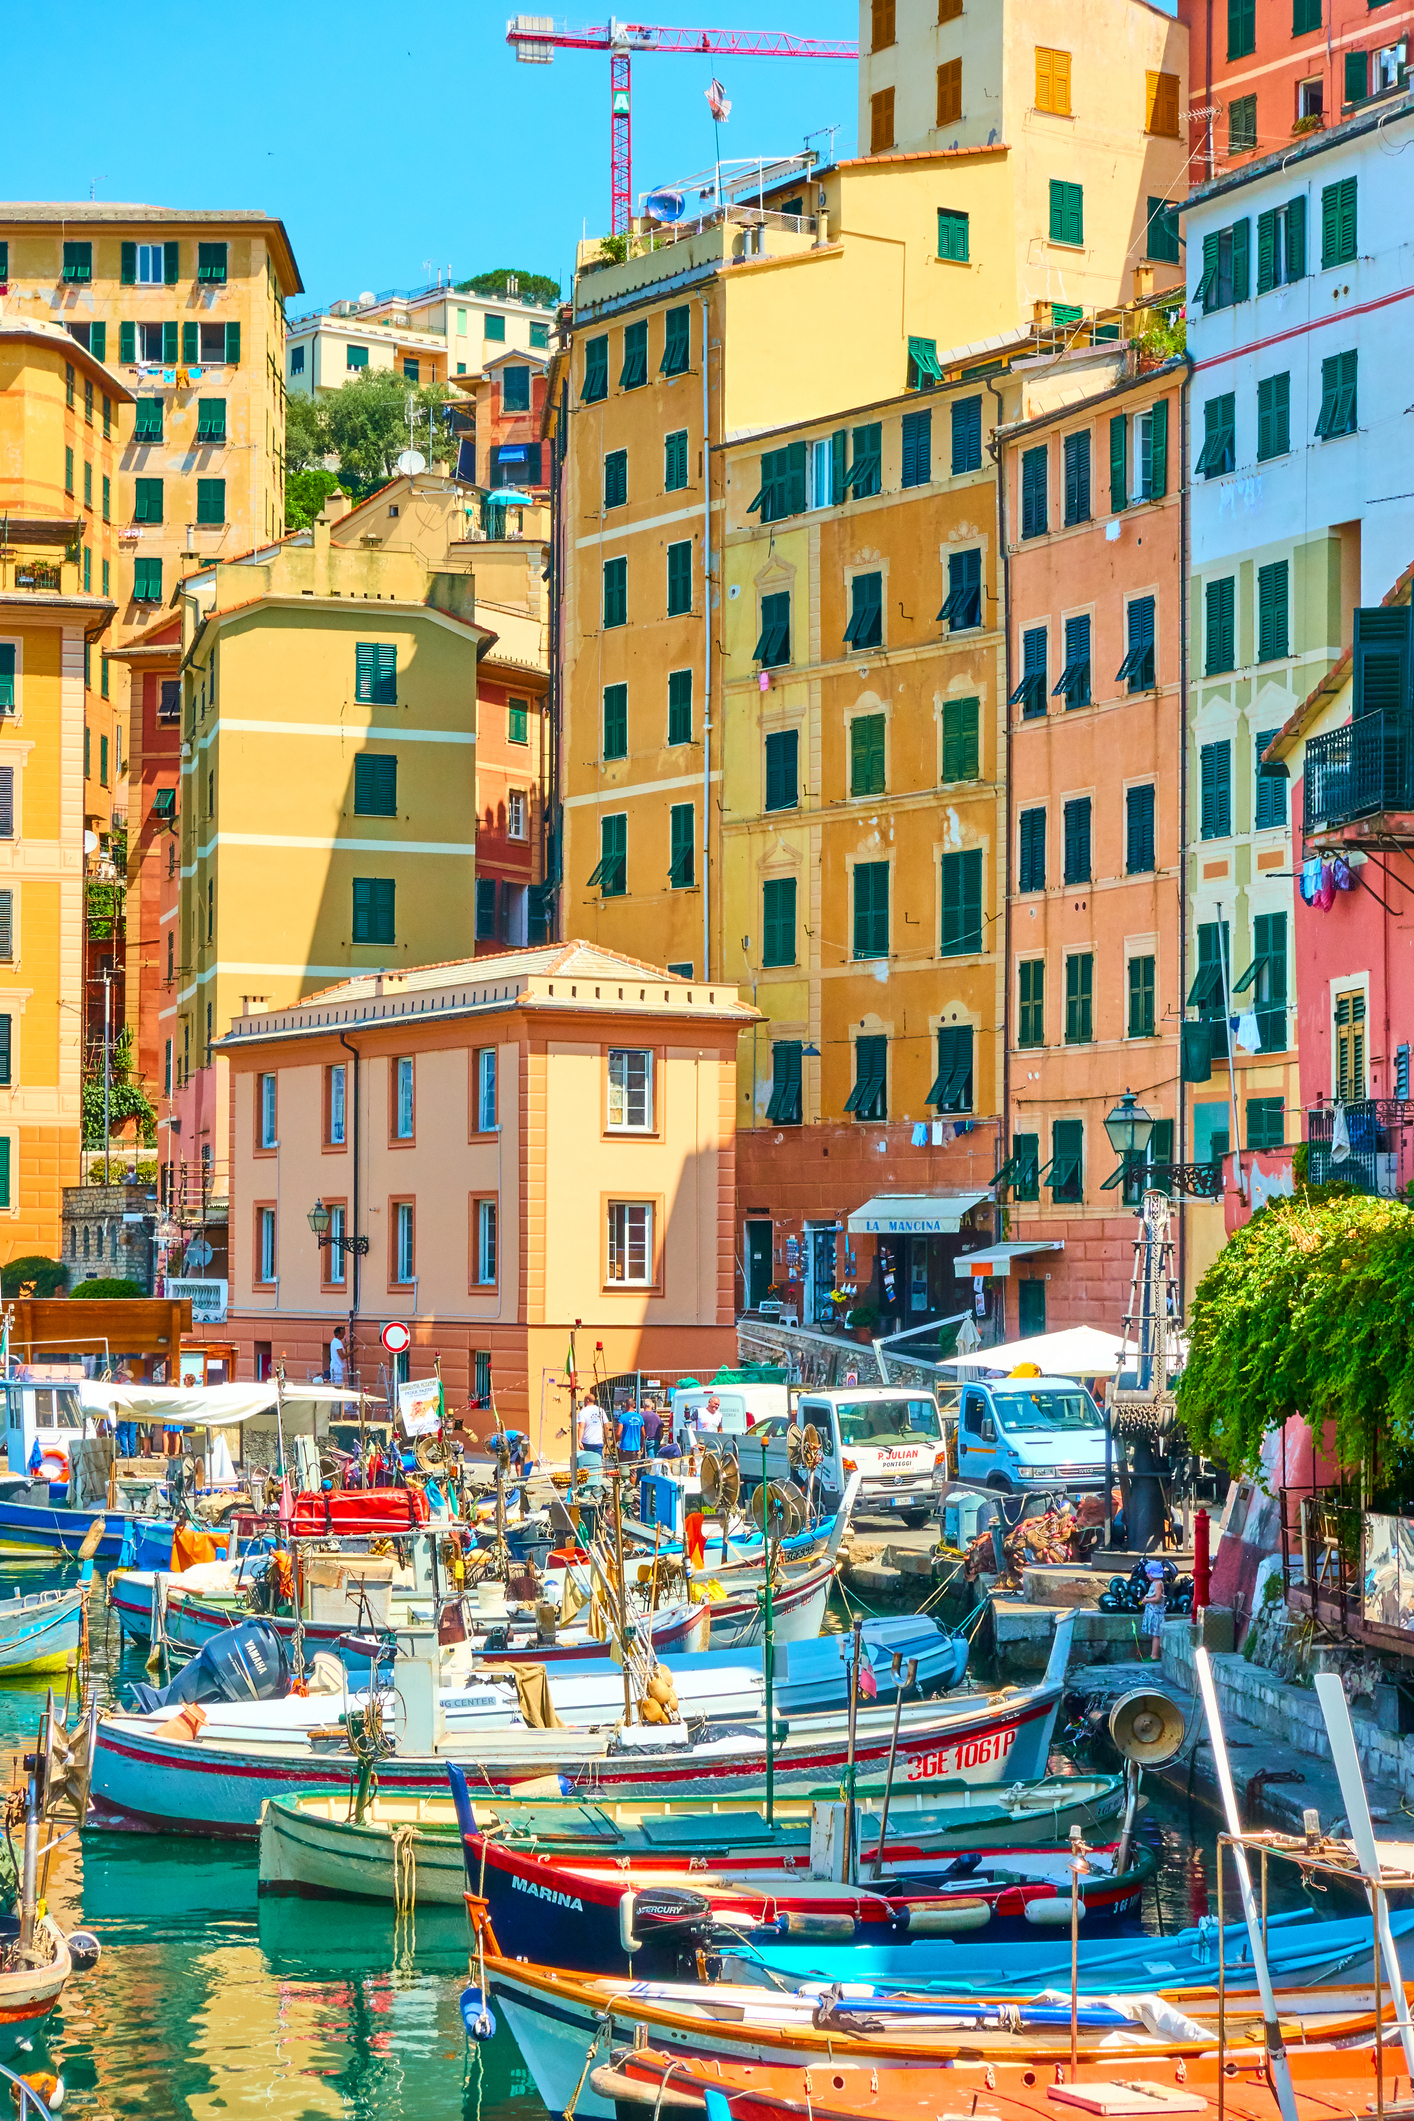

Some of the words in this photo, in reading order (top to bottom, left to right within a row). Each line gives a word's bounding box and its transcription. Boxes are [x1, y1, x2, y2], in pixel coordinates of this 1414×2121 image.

[614, 94, 629, 110] A
[866, 1221, 879, 1231] LA
[889, 1220, 940, 1231] MANCINA
[877, 1452, 884, 1461] P.
[886, 1449, 918, 1460] JULIAN
[244, 1639, 268, 1675] YAMAHA
[454, 1697, 494, 1707] CENTER
[907, 1749, 950, 1781] 3GE
[511, 1875, 584, 1912] MARINA
